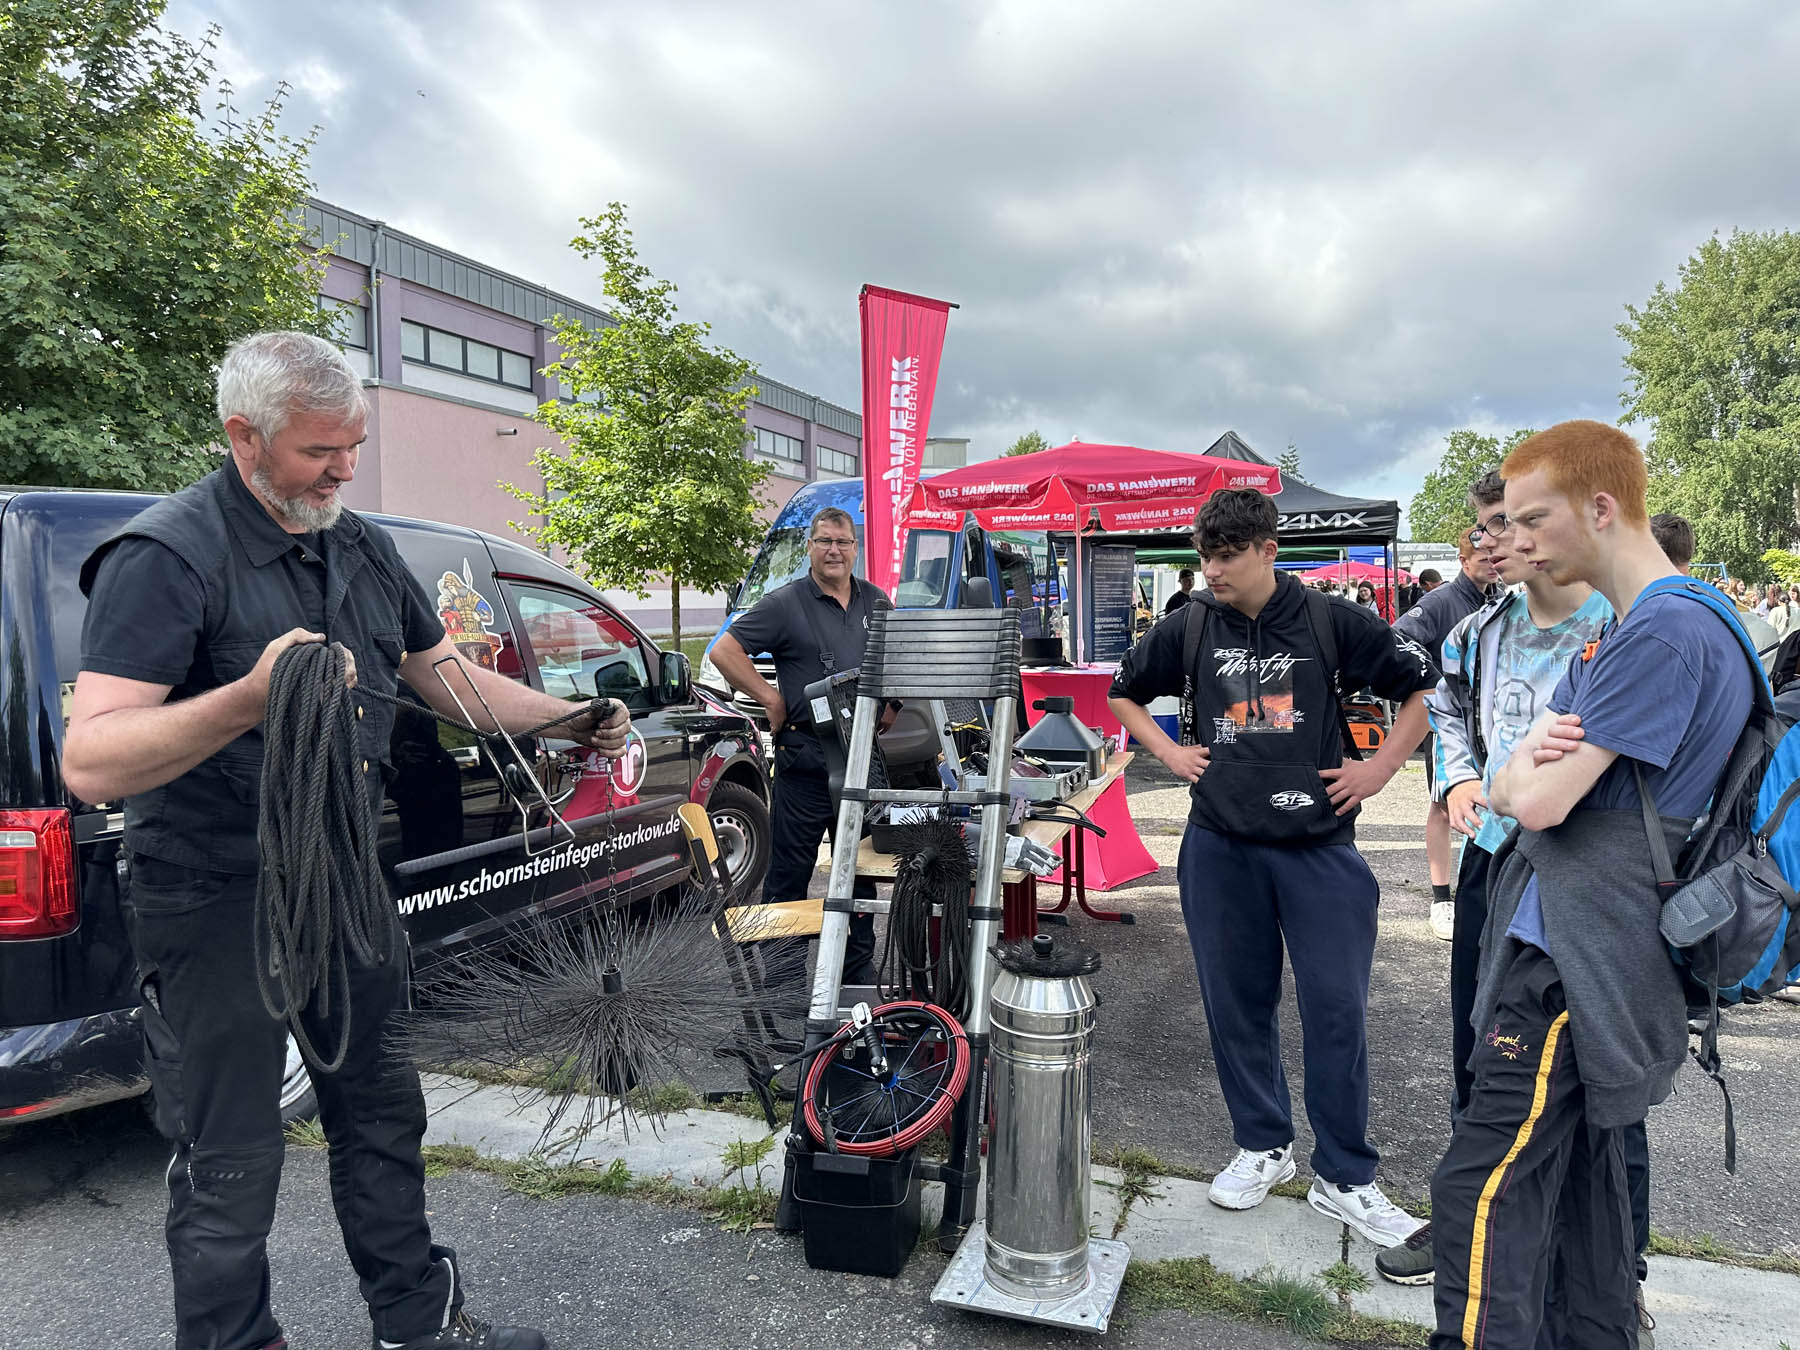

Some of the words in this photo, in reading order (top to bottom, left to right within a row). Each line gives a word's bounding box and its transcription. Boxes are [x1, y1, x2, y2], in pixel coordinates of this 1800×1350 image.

[937, 487, 959, 499] DAS
[961, 480, 1029, 496] HANDWERK
[1086, 482, 1116, 494] DAS
[1118, 475, 1197, 491] HANDWERK
[396, 813, 681, 916] www.schornsteinfeger-storkow.de
